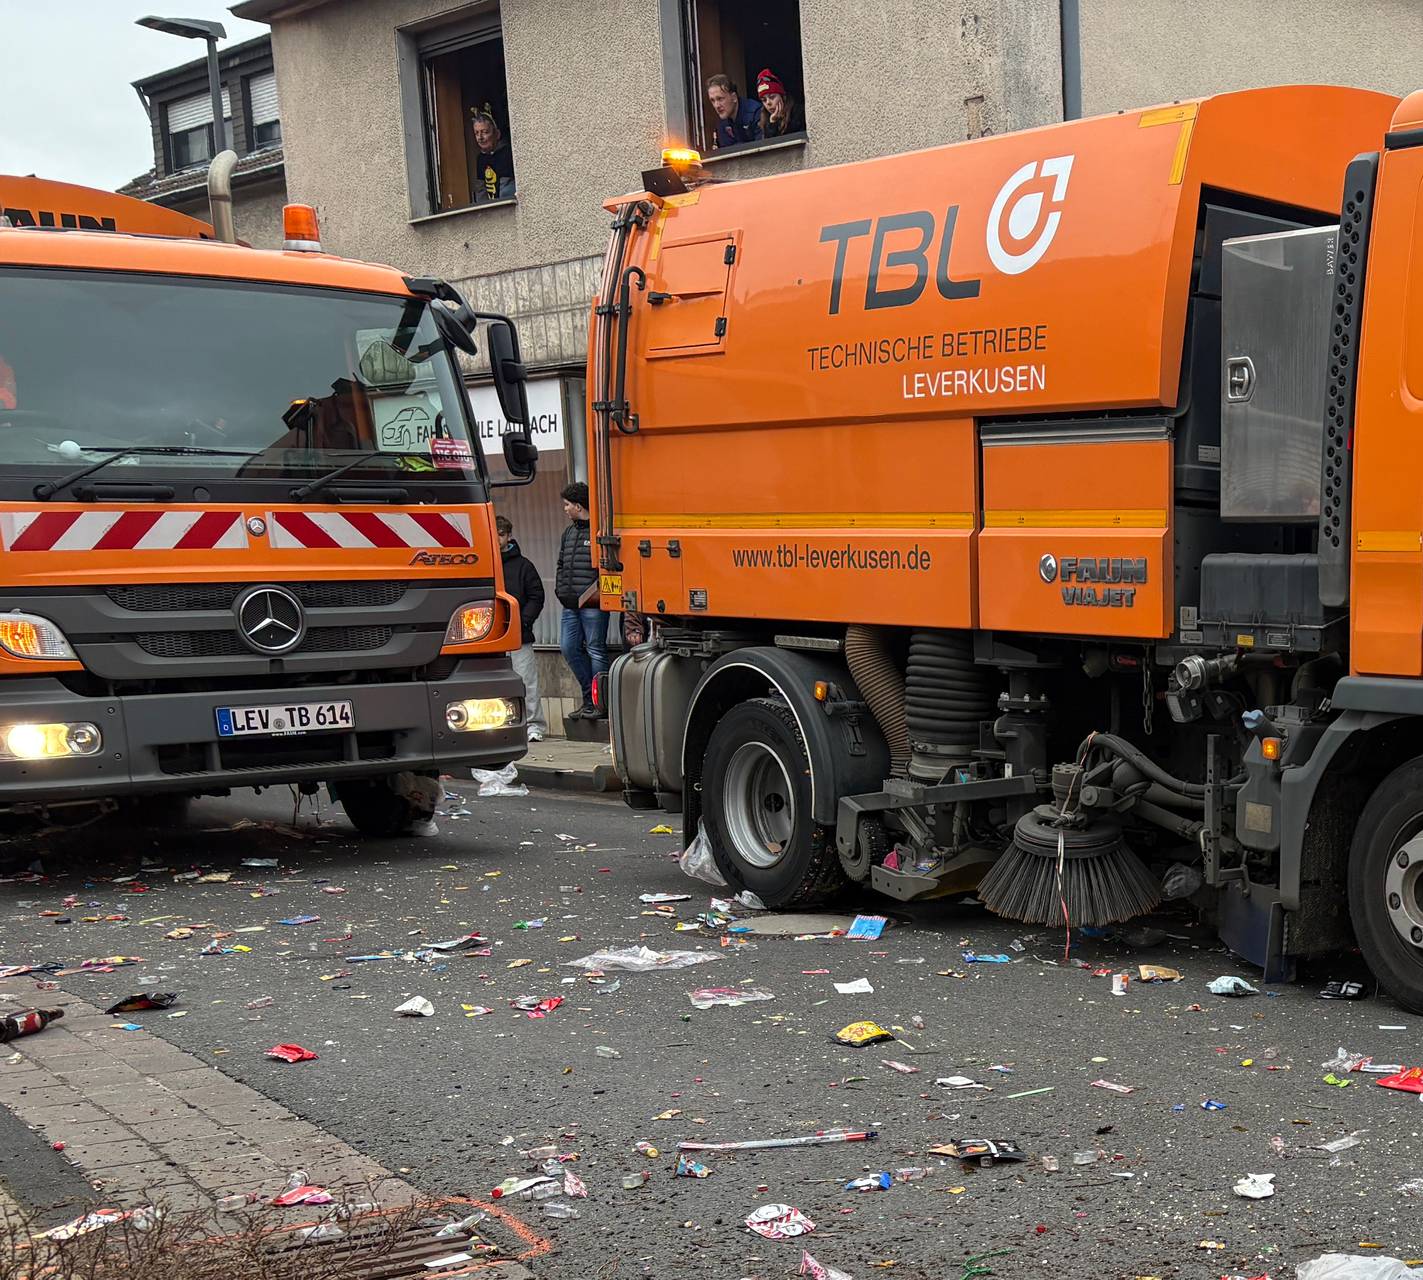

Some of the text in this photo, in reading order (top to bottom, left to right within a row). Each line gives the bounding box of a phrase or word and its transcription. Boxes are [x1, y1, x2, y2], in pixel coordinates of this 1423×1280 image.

[1, 208, 116, 232] AUN
[819, 204, 981, 315] TBL
[808, 325, 1047, 371] TECHNISCHE BETRIEBE
[903, 364, 1046, 398] LEVERKUSEN
[733, 543, 931, 571] www.tbl-leverkusen.de
[1060, 557, 1147, 584] FAUN
[1062, 587, 1136, 607] VIAJET
[232, 709, 269, 731] LEV
[285, 706, 310, 727] TB
[315, 704, 350, 726] 614
